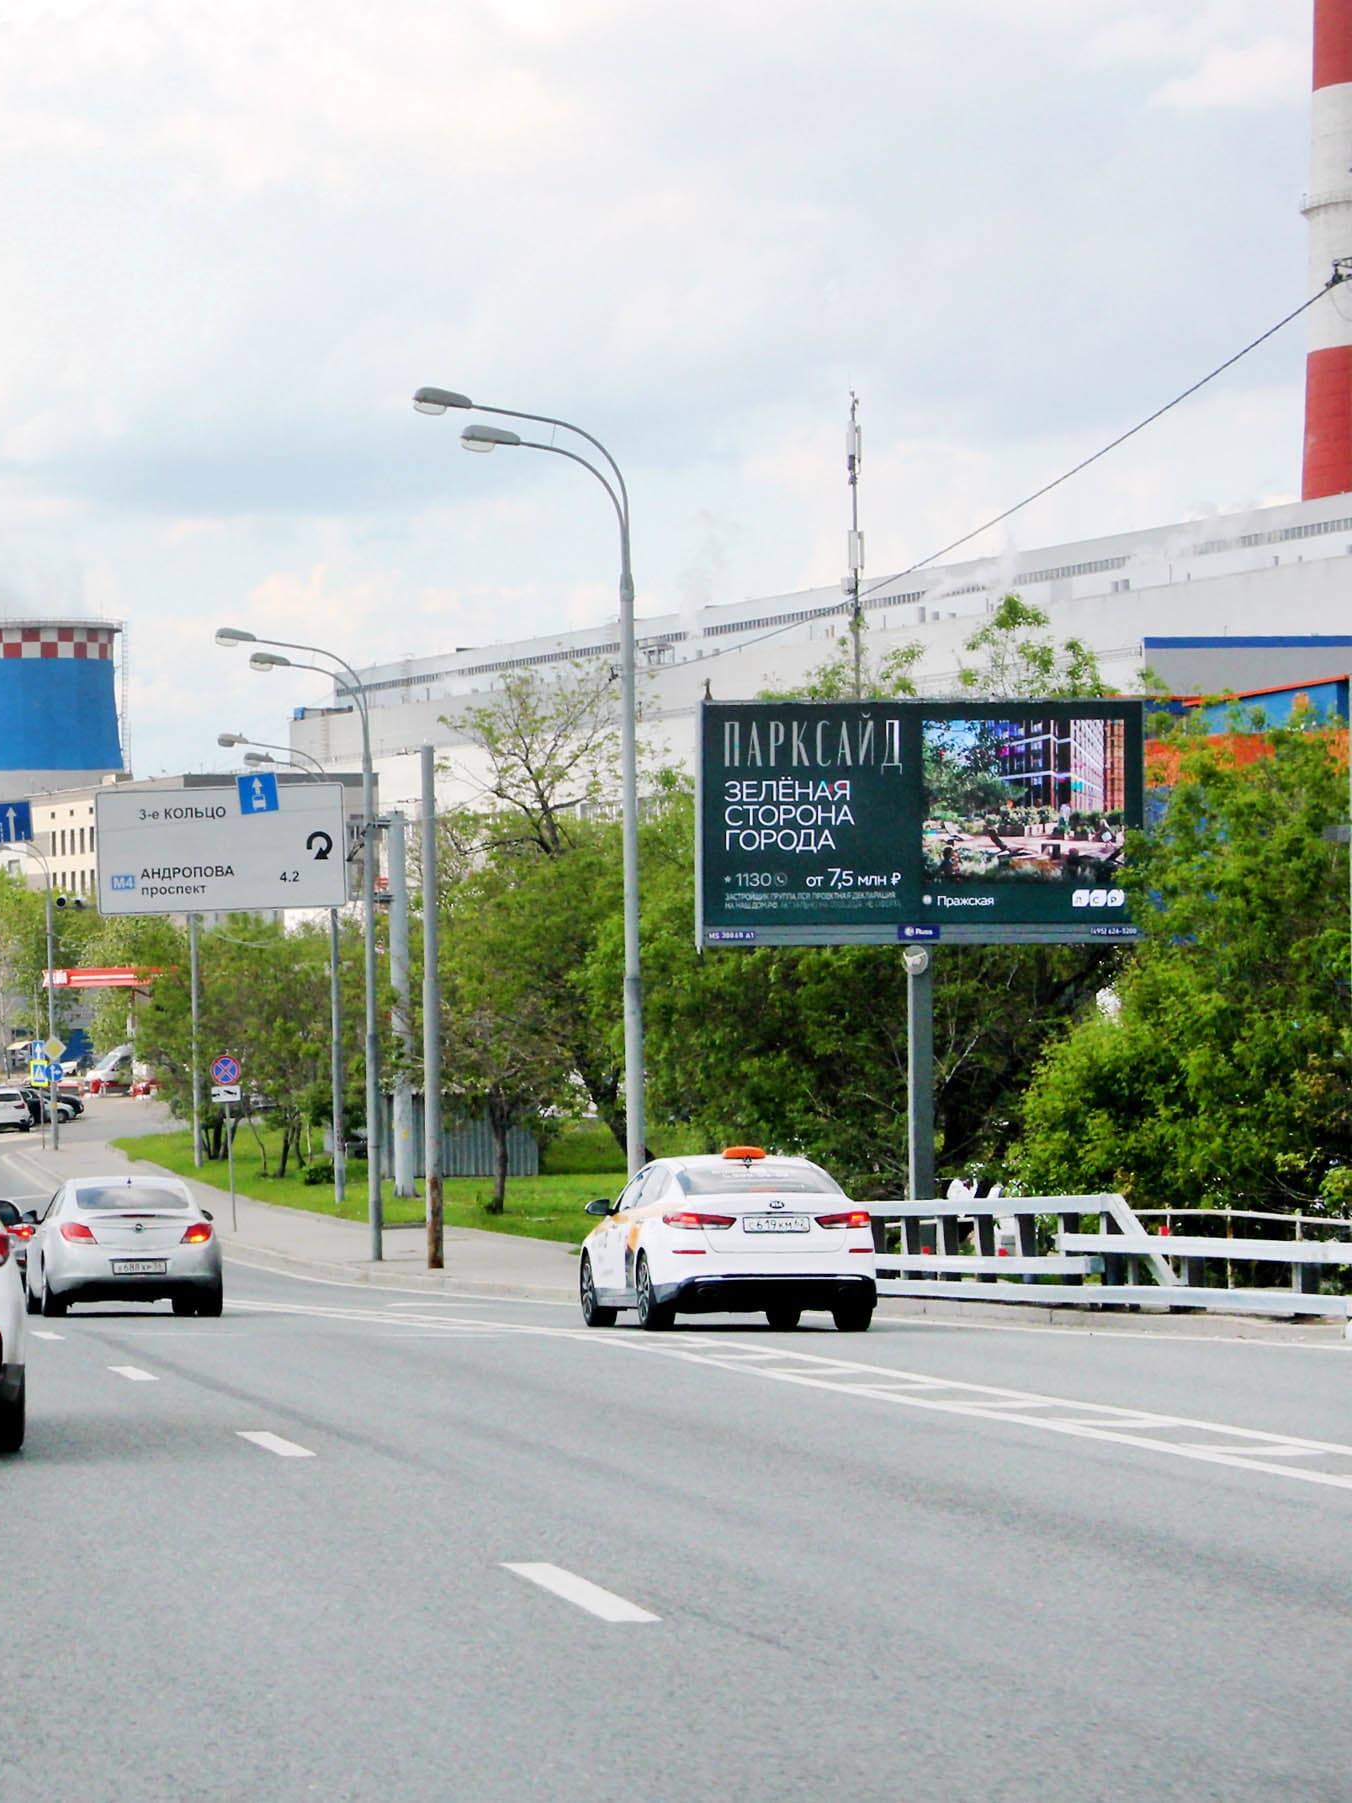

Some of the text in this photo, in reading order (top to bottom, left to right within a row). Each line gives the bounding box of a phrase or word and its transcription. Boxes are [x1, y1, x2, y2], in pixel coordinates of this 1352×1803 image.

[724, 712, 902, 776] ПАРКСАЙД
[724, 776, 851, 801] ЗЕЛЁНАЯ
[139, 806, 226, 820] 3-е КОЛЬЦО
[724, 805, 855, 826] СТОРОНА
[725, 829, 836, 853] ГОРОДА
[141, 865, 235, 881] АНДРОПОВА
[279, 871, 300, 882] 4.2
[805, 876, 824, 887] от
[827, 868, 854, 889] 7,5
[858, 875, 887, 887] млн
[141, 884, 207, 897] проспект
[936, 895, 995, 907] Пражская
